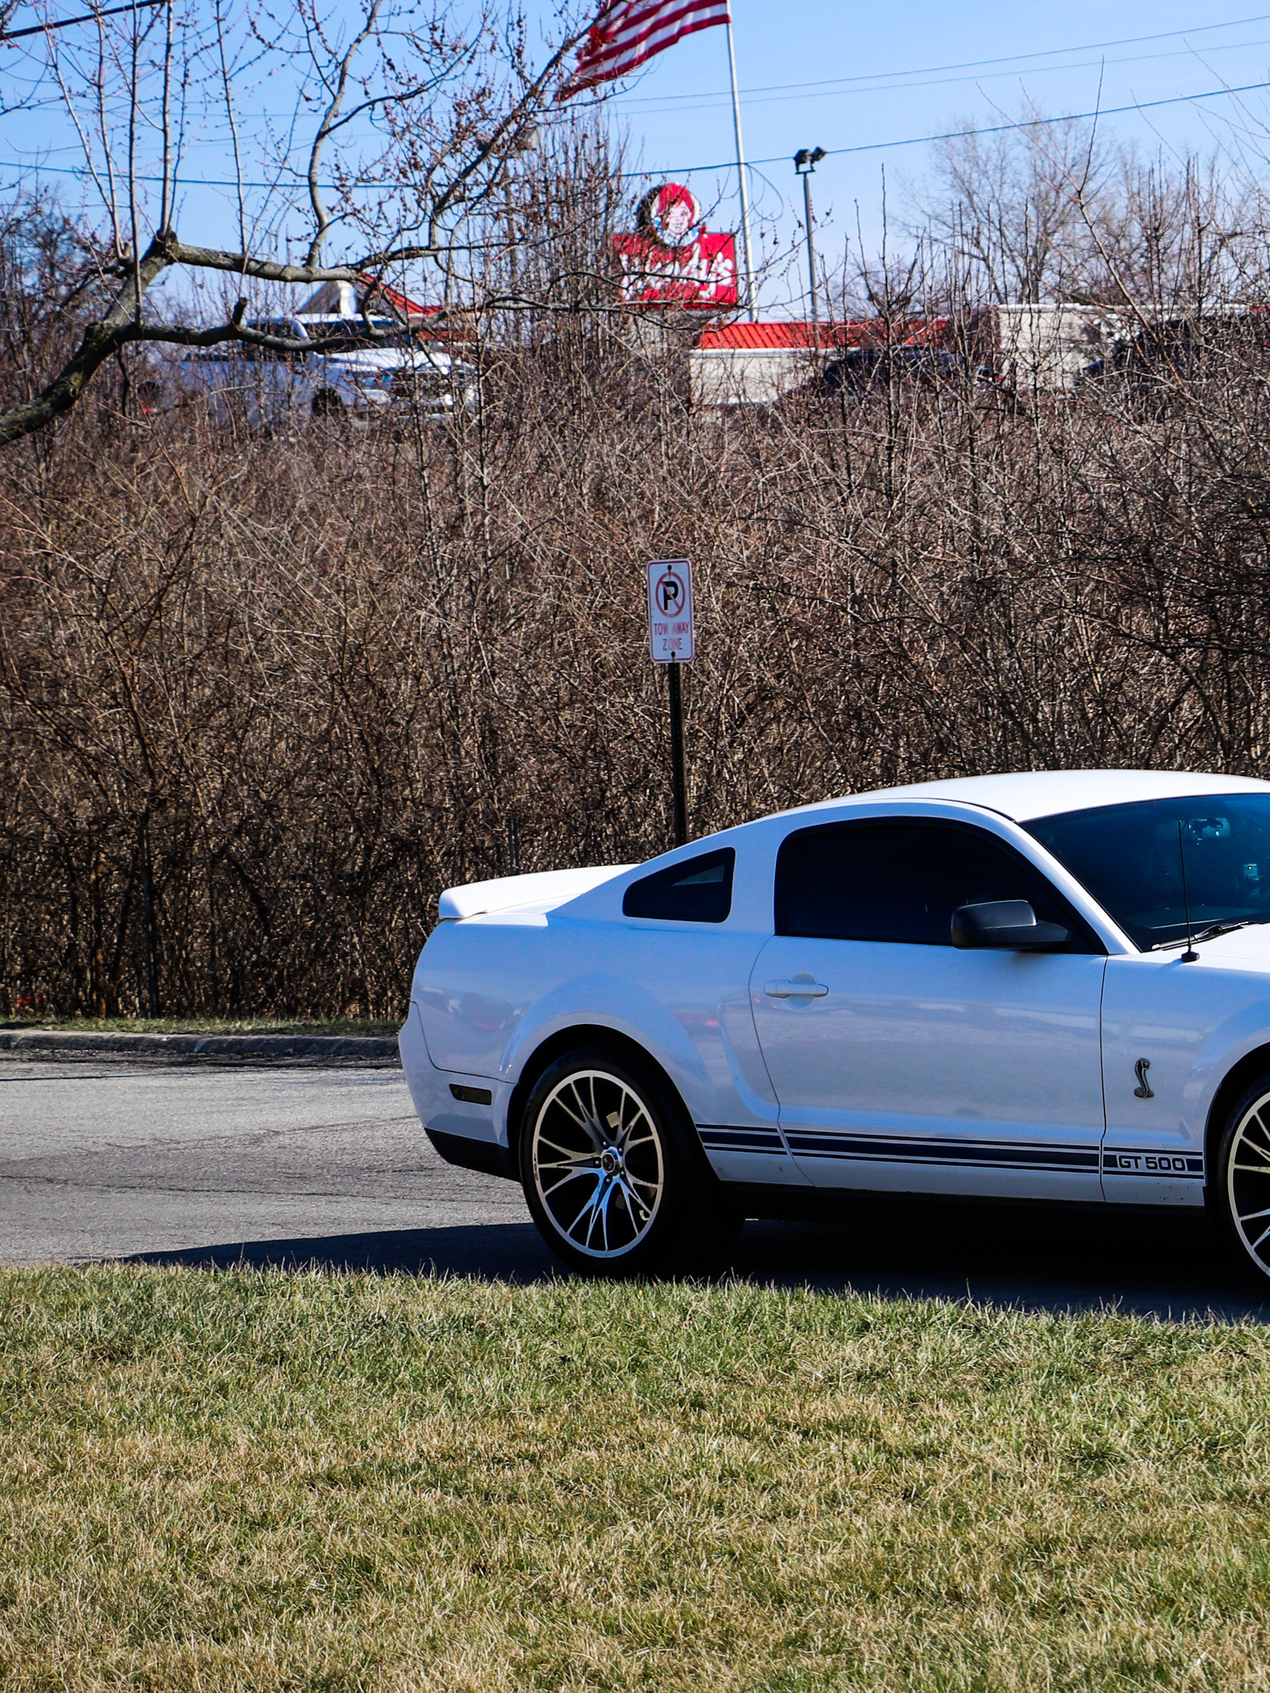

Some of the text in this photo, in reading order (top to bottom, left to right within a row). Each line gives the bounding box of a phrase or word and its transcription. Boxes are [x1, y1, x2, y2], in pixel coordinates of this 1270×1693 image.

[653, 621, 690, 636] TOW AWAY
[662, 637, 683, 651] ZONE
[1118, 1154, 1186, 1172] GT 500
